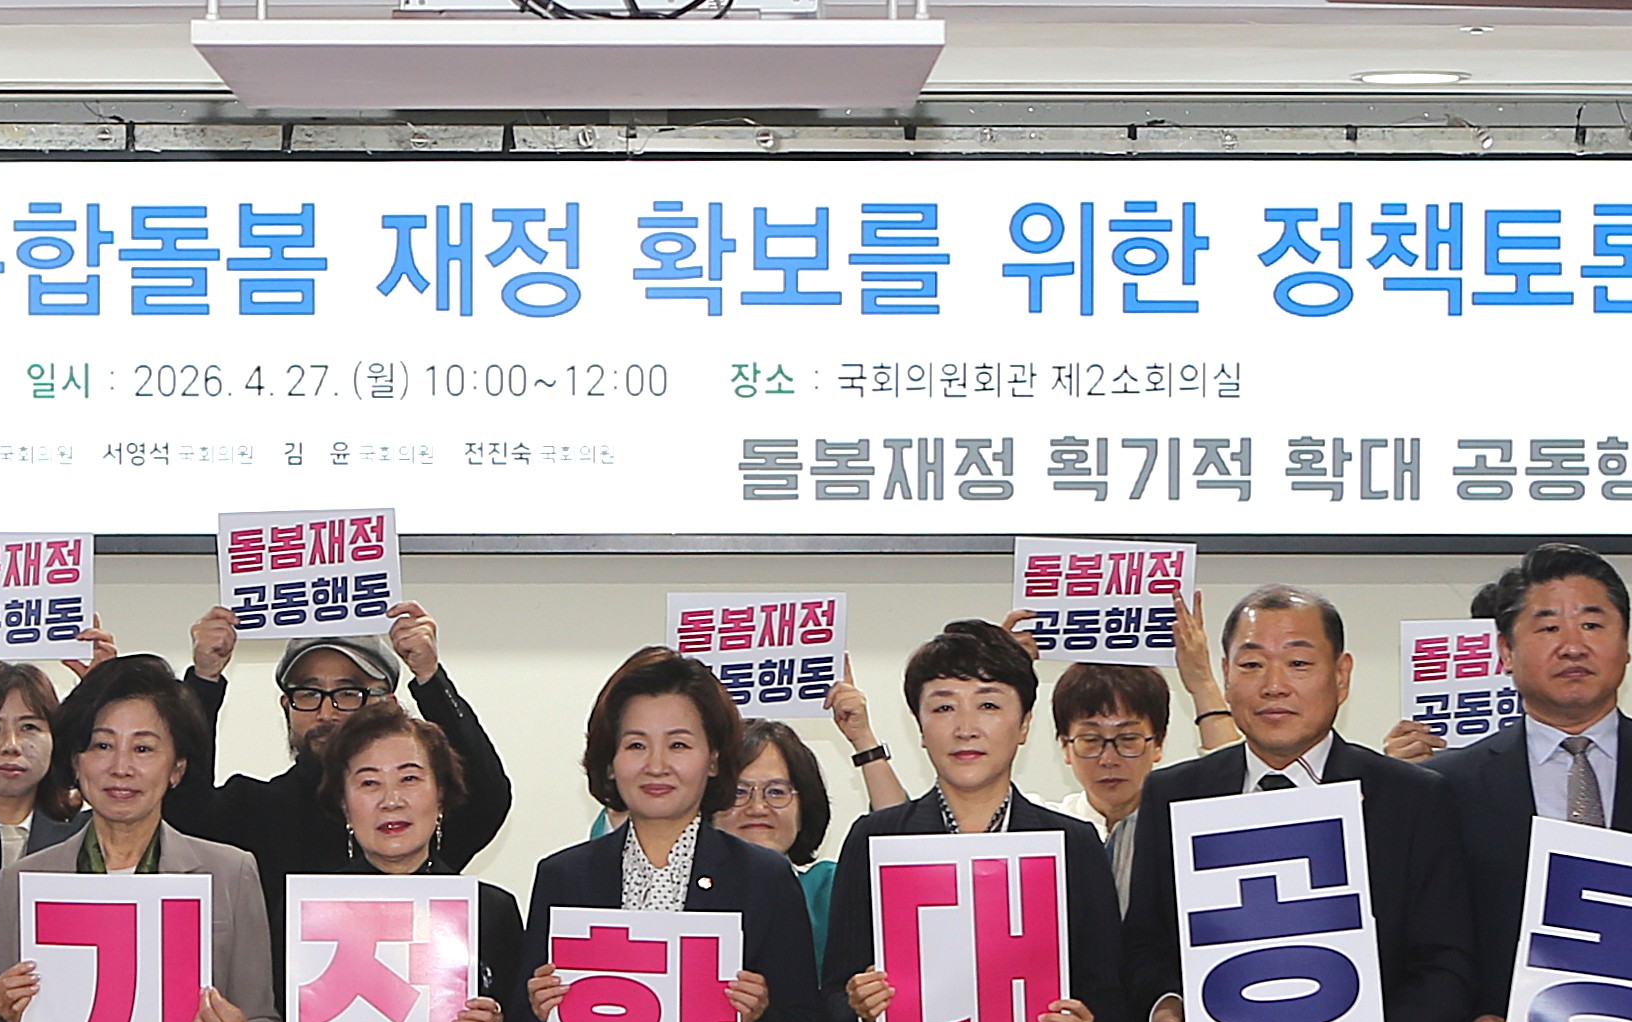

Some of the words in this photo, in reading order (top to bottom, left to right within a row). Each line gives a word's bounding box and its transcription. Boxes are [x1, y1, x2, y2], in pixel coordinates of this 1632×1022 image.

[376, 202, 581, 318] 재정
[633, 201, 950, 316] 확보를
[1002, 200, 1210, 316] 위한
[27, 362, 89, 399] 일시
[426, 364, 667, 397] 10:00~12:00
[731, 362, 796, 398] 장소
[838, 363, 1038, 398] 국회의원회관
[1052, 363, 1241, 398] 제2소회의실
[102, 442, 170, 466] 서영석
[465, 442, 532, 466] 전진숙
[738, 436, 1014, 501] 돌봄재정
[1047, 436, 1251, 502] 획기적
[1285, 436, 1420, 502] 확대
[228, 515, 385, 574] 돌봄재정
[1024, 550, 1184, 598] 돌봄재정
[231, 572, 390, 630] 공동행동
[677, 599, 835, 653] 돌봄재정
[1029, 607, 1177, 650] 공동행동
[716, 656, 834, 705] 동행동
[1411, 633, 1512, 682] 돌봄
[1413, 686, 1523, 738] 공동
